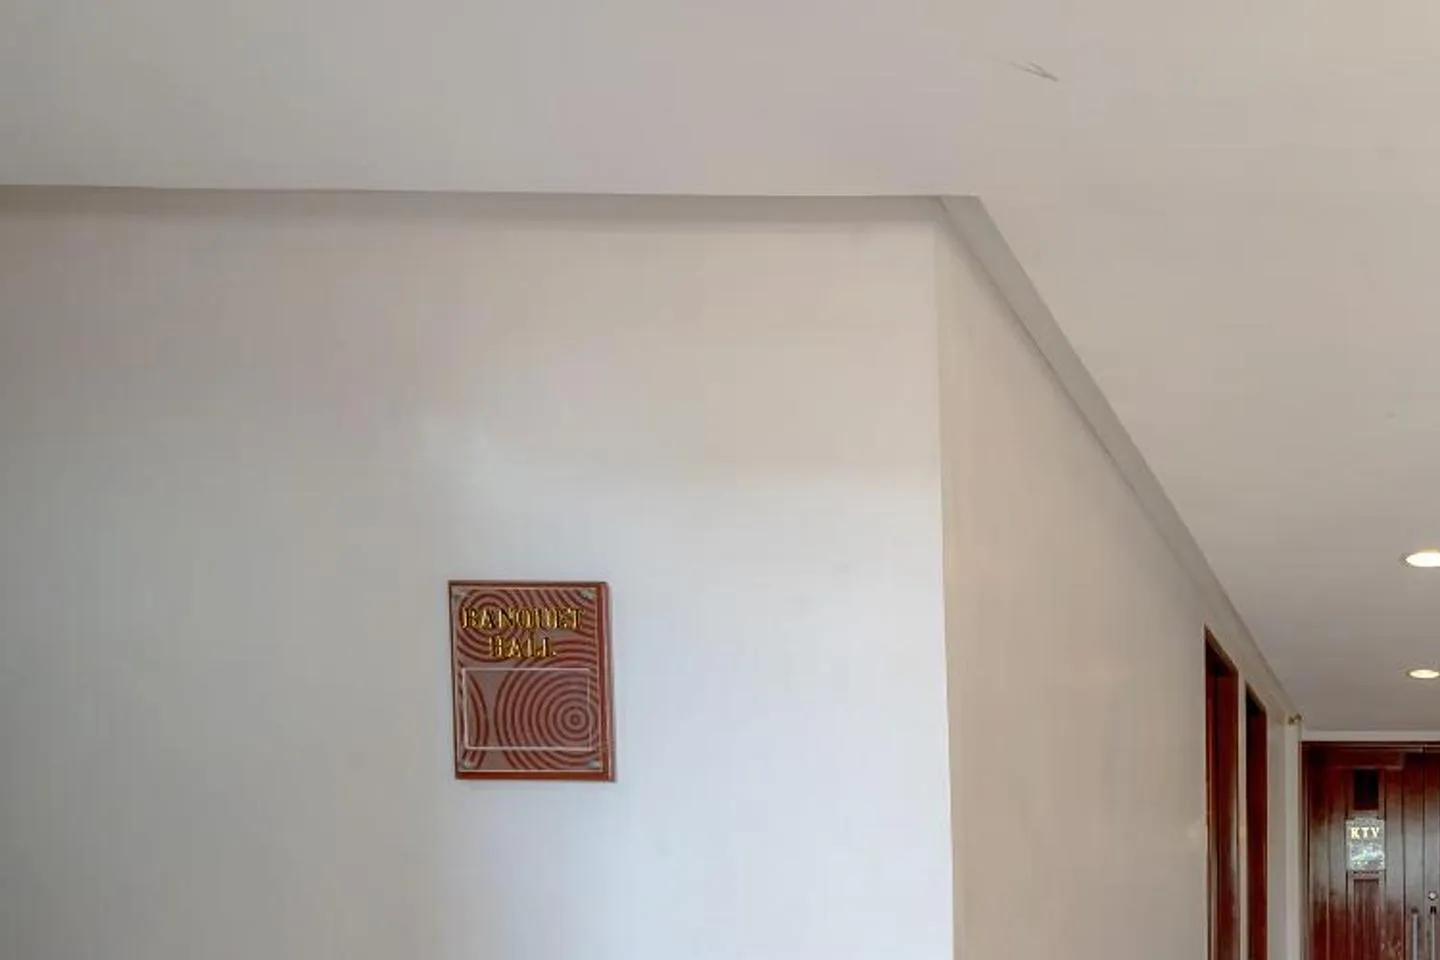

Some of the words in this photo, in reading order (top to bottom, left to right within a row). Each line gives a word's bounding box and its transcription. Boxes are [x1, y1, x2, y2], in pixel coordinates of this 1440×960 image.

[462, 606, 583, 630] BANQUET
[488, 635, 559, 659] HALL
[1350, 827, 1380, 840] KTV
